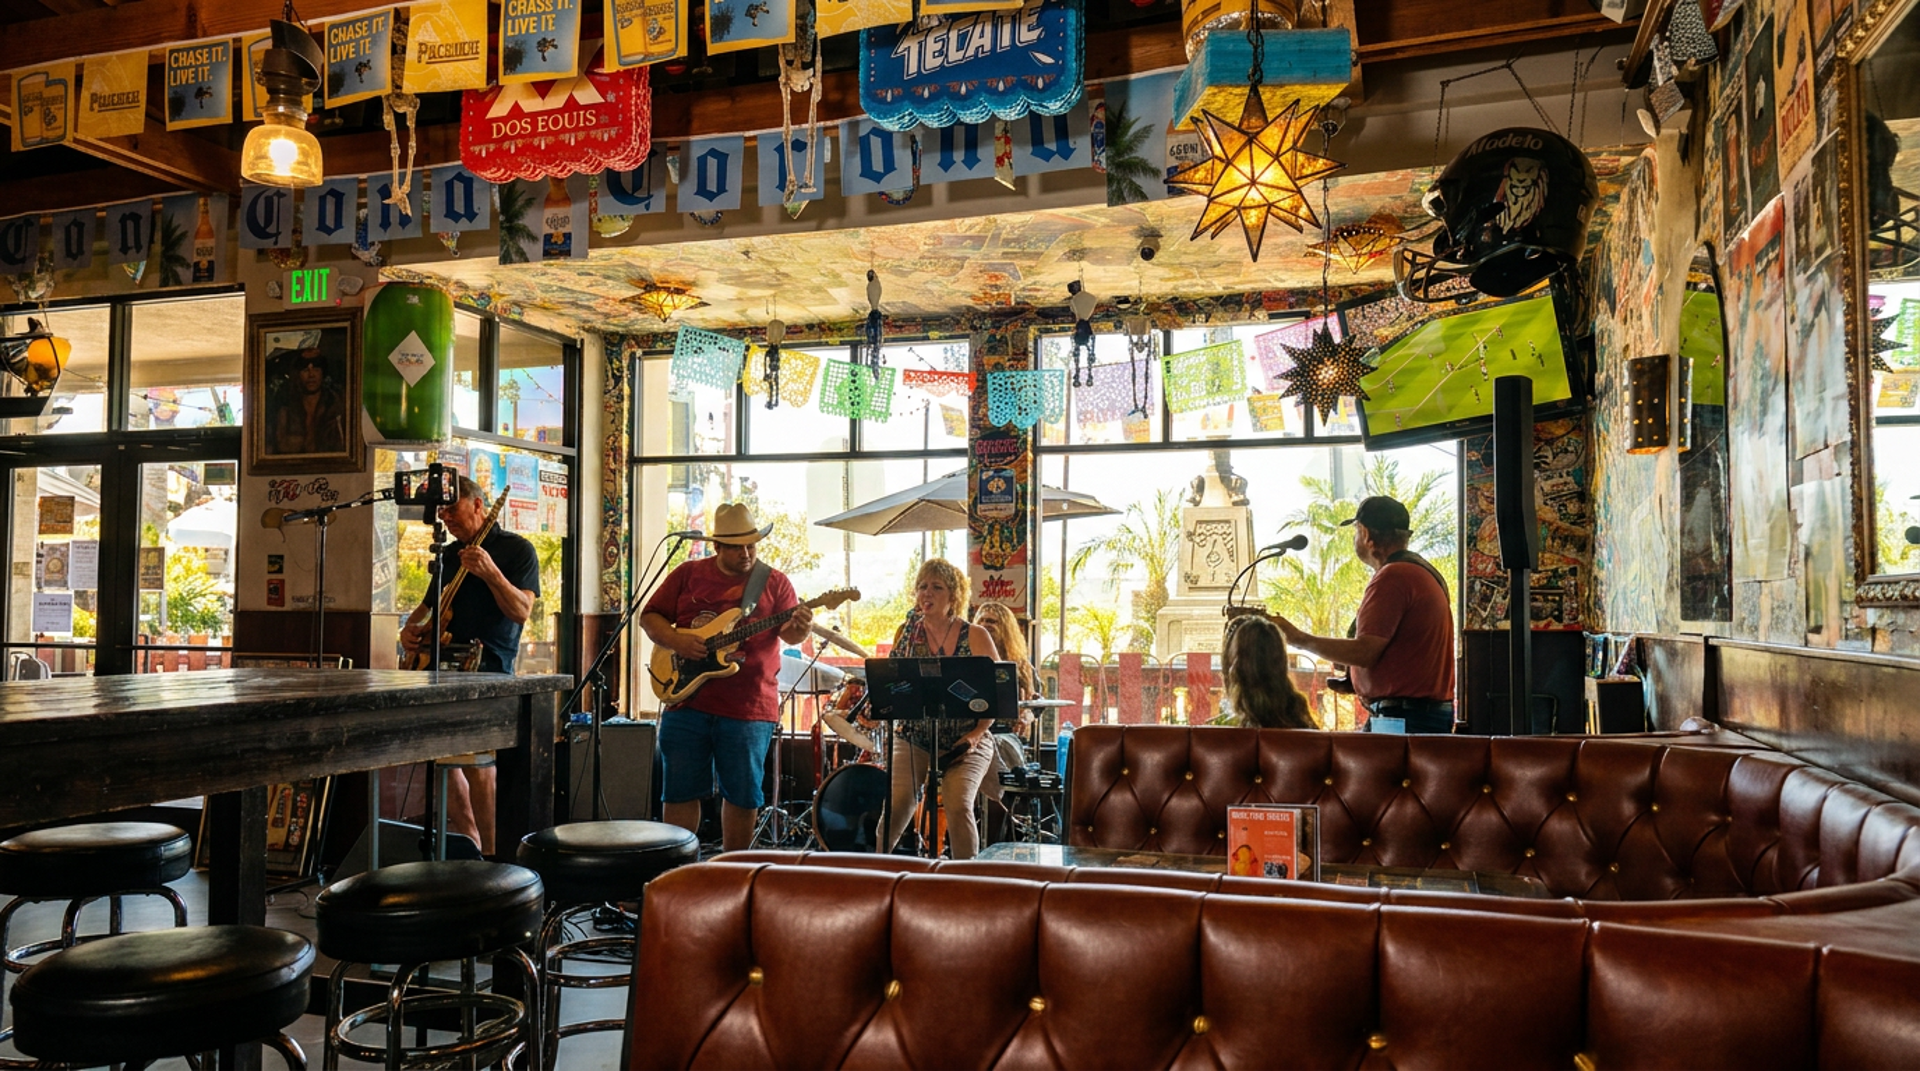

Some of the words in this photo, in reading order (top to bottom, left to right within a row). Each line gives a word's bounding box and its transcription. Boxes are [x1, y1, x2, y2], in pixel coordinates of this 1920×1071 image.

[330, 20, 370, 45] CHASE
[507, 16, 539, 37] LIVE
[330, 41, 357, 64] LIVE
[891, 2, 1046, 80] TECATE
[170, 48, 210, 68] CHASE
[211, 45, 227, 63] IT.
[169, 67, 196, 87] LIVE
[198, 65, 213, 83] IT.
[491, 117, 532, 139] DOS
[291, 267, 331, 304] EXIT
